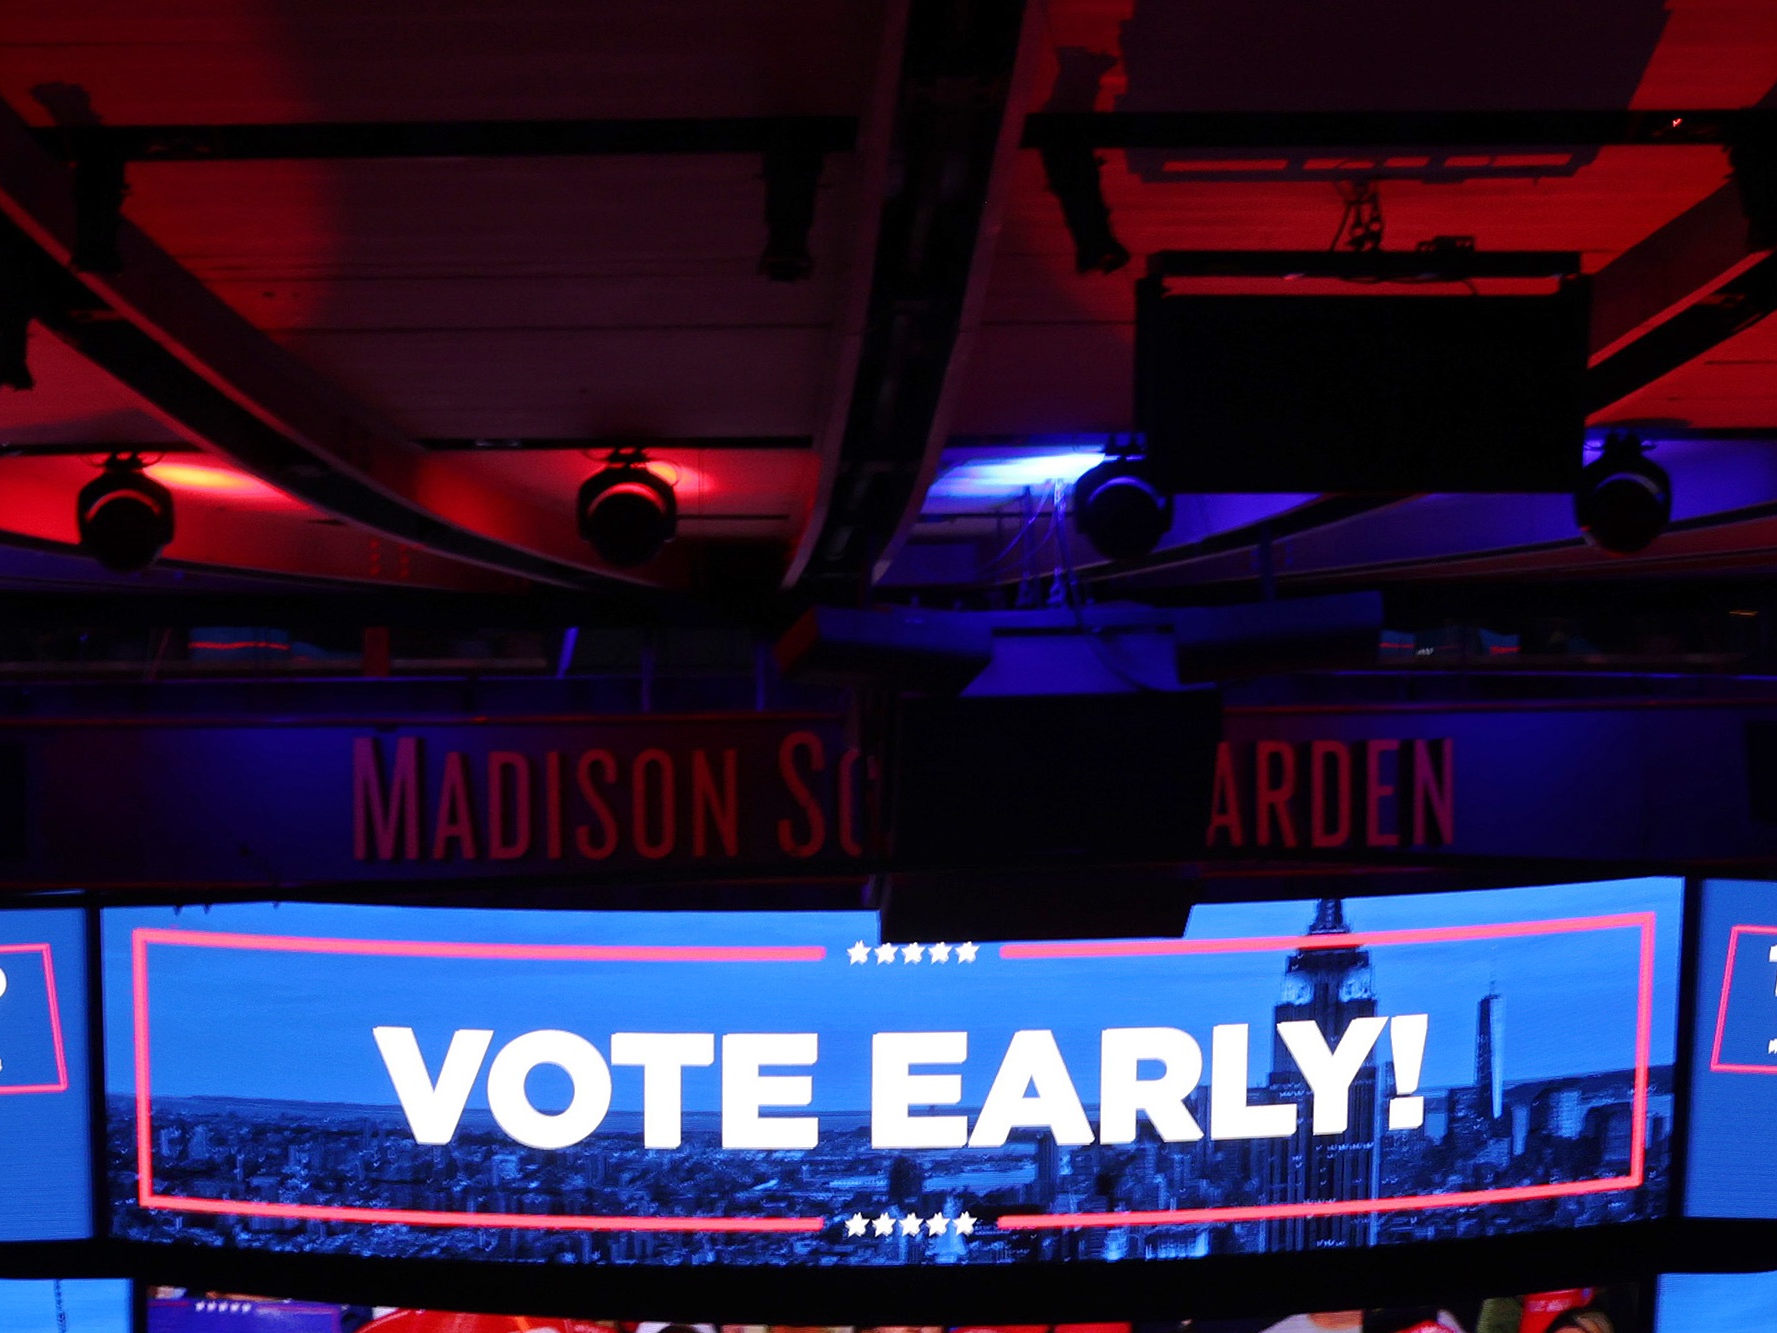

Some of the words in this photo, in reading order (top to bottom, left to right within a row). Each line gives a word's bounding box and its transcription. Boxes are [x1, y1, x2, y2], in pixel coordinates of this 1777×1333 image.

[351, 736, 739, 861] MADISON
[372, 1027, 819, 1150] VOTE
[871, 1013, 1430, 1149] EARLY!
